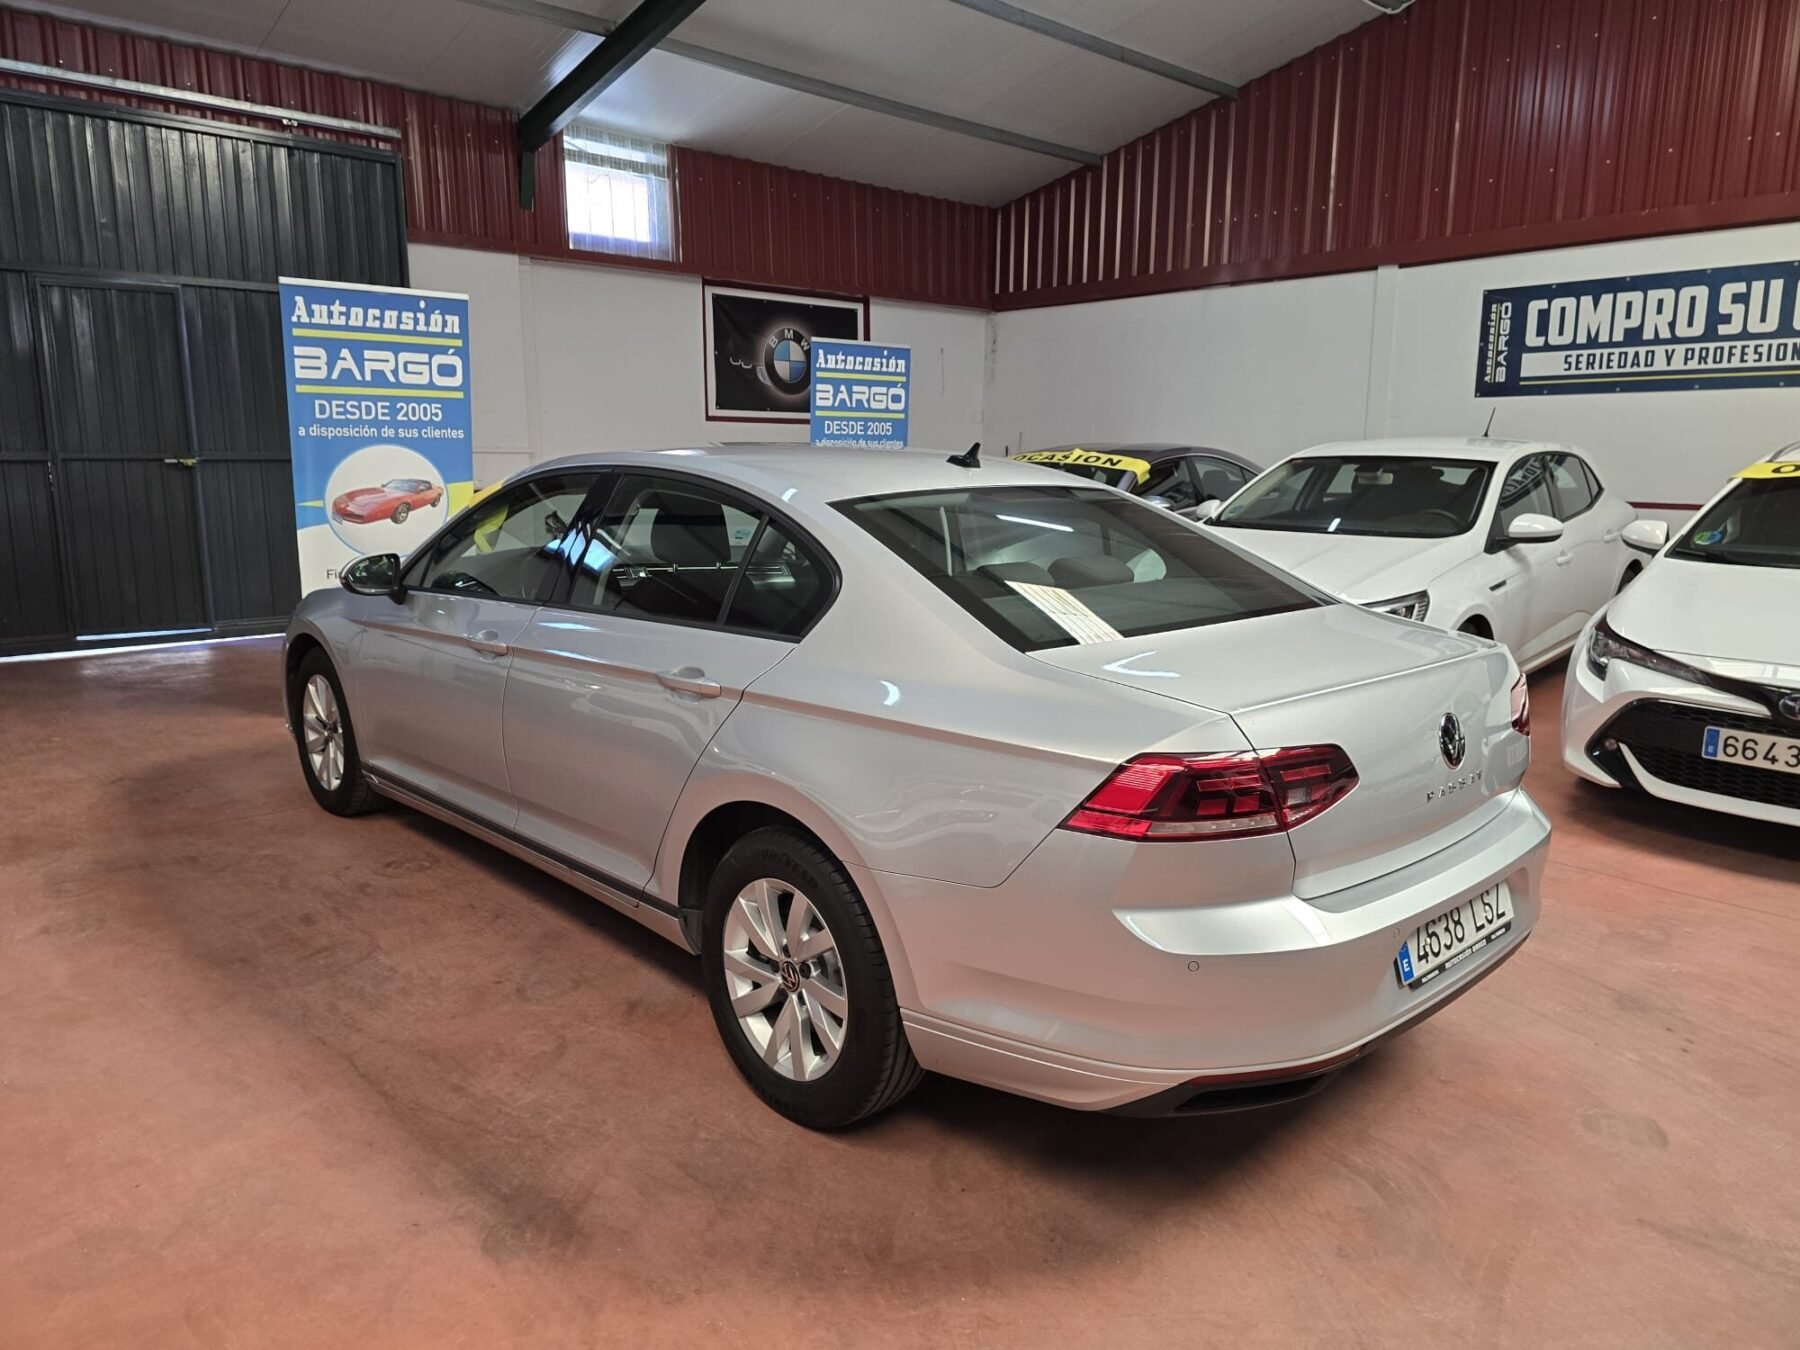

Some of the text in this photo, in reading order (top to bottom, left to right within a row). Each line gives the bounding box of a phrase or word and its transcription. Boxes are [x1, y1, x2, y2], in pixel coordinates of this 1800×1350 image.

[1525, 286, 1709, 347] COMPRO
[1717, 278, 1784, 335] SU
[768, 328, 811, 351] BMW
[294, 346, 463, 387] BARGÓ
[1563, 349, 1654, 372] SERIEDAD
[1665, 348, 1676, 367] Y
[815, 383, 905, 411] BARGÓ
[314, 399, 443, 422] DESDE 2005
[298, 424, 465, 440] a disposición de sus clientes
[824, 420, 893, 436] DESDE 2005
[1722, 735, 1800, 768] 6643
[1416, 907, 1464, 964] 4638
[1402, 959, 1411, 972] E
